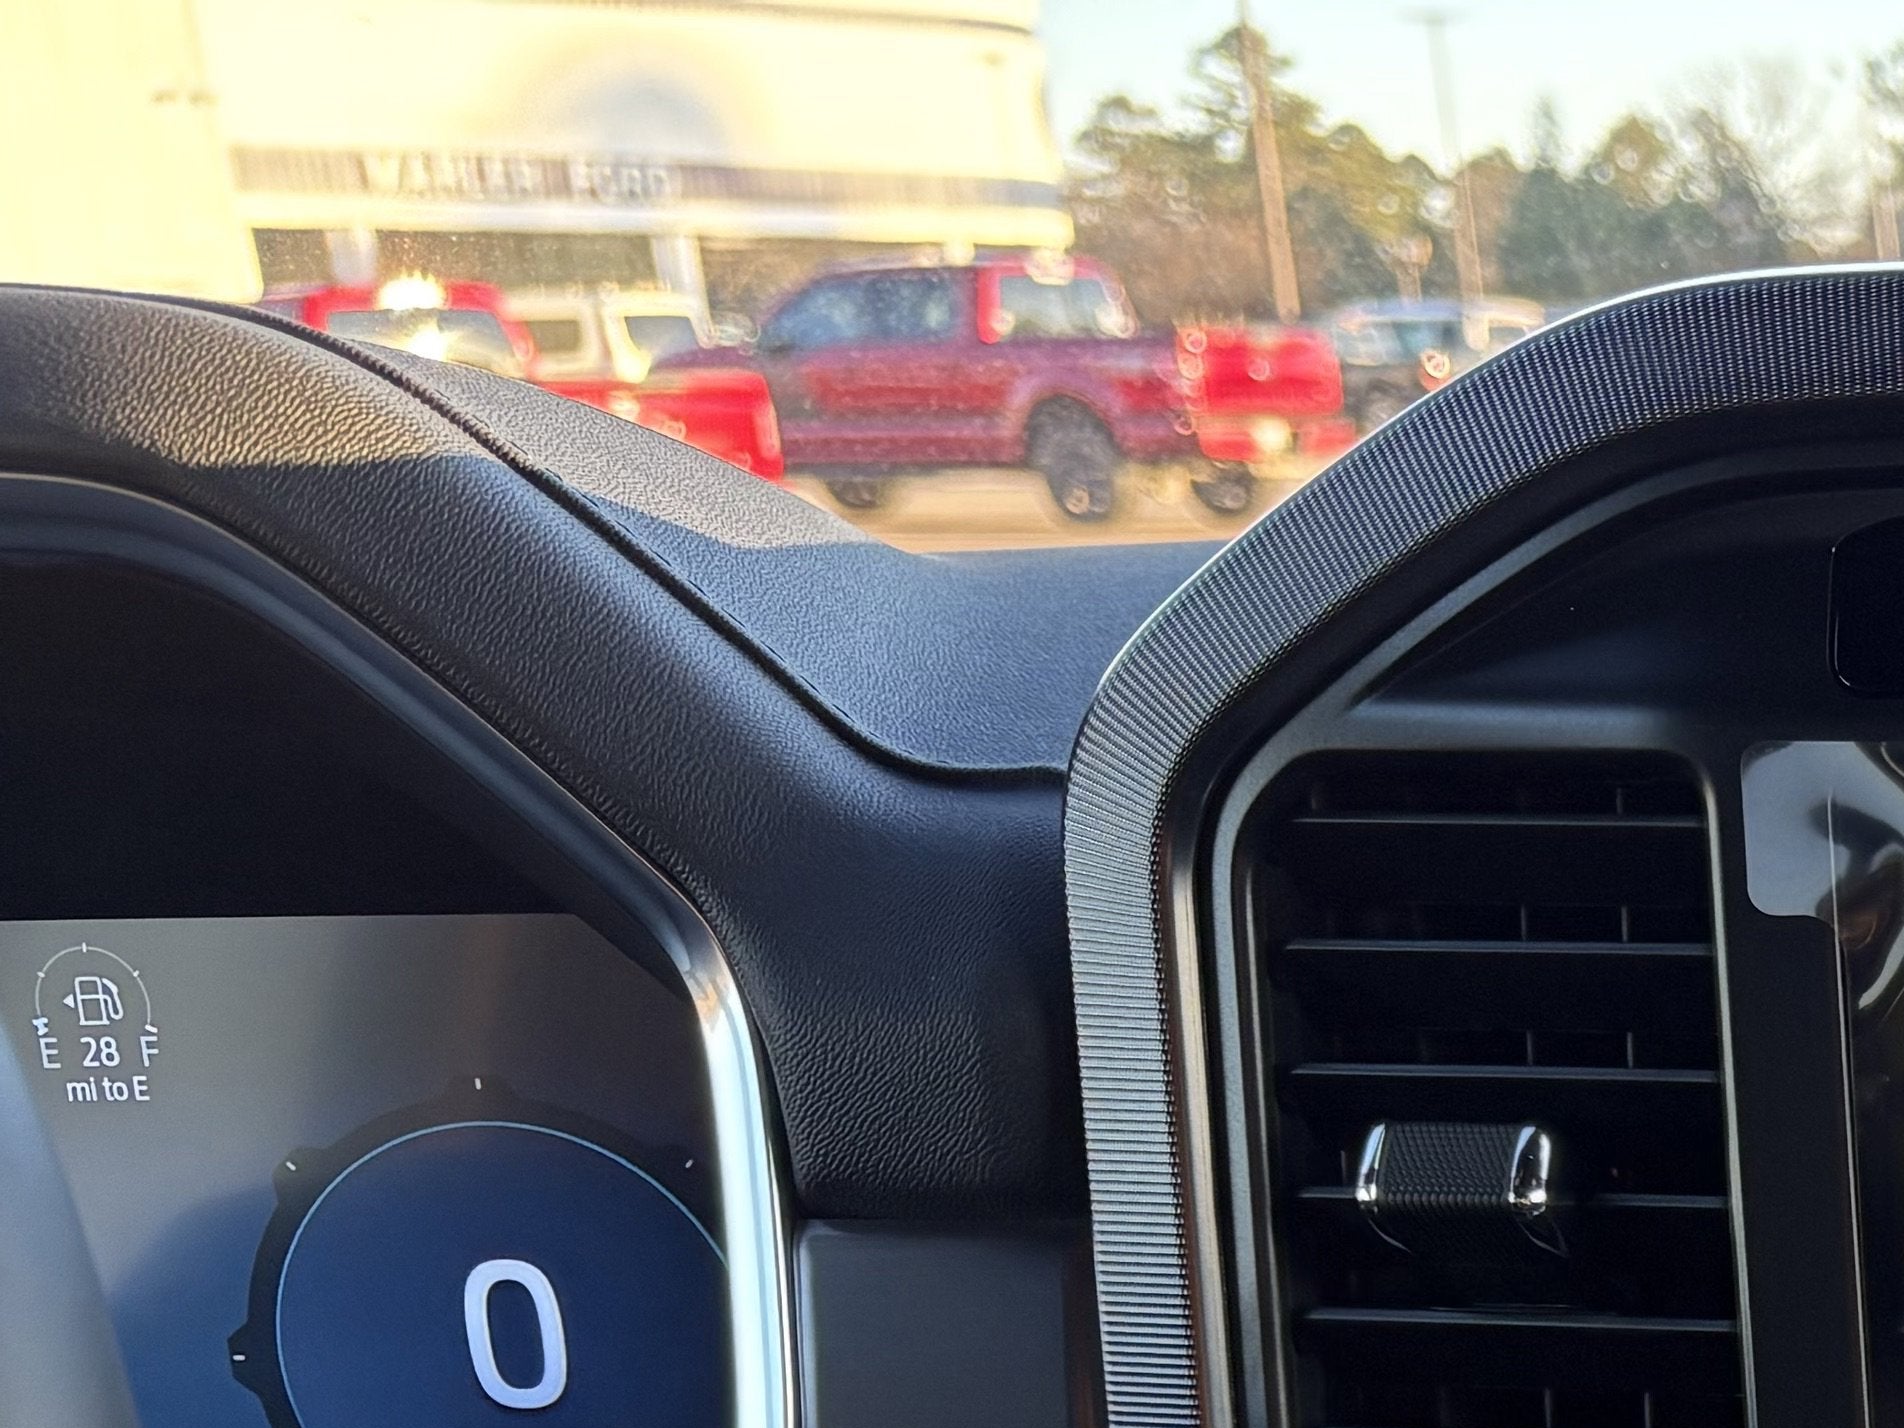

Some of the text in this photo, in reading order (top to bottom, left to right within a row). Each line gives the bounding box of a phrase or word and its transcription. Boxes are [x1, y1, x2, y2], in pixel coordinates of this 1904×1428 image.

[41, 1036, 161, 1070] E 28 F
[66, 1075, 151, 1103] mi to E
[463, 1258, 570, 1411] 0
